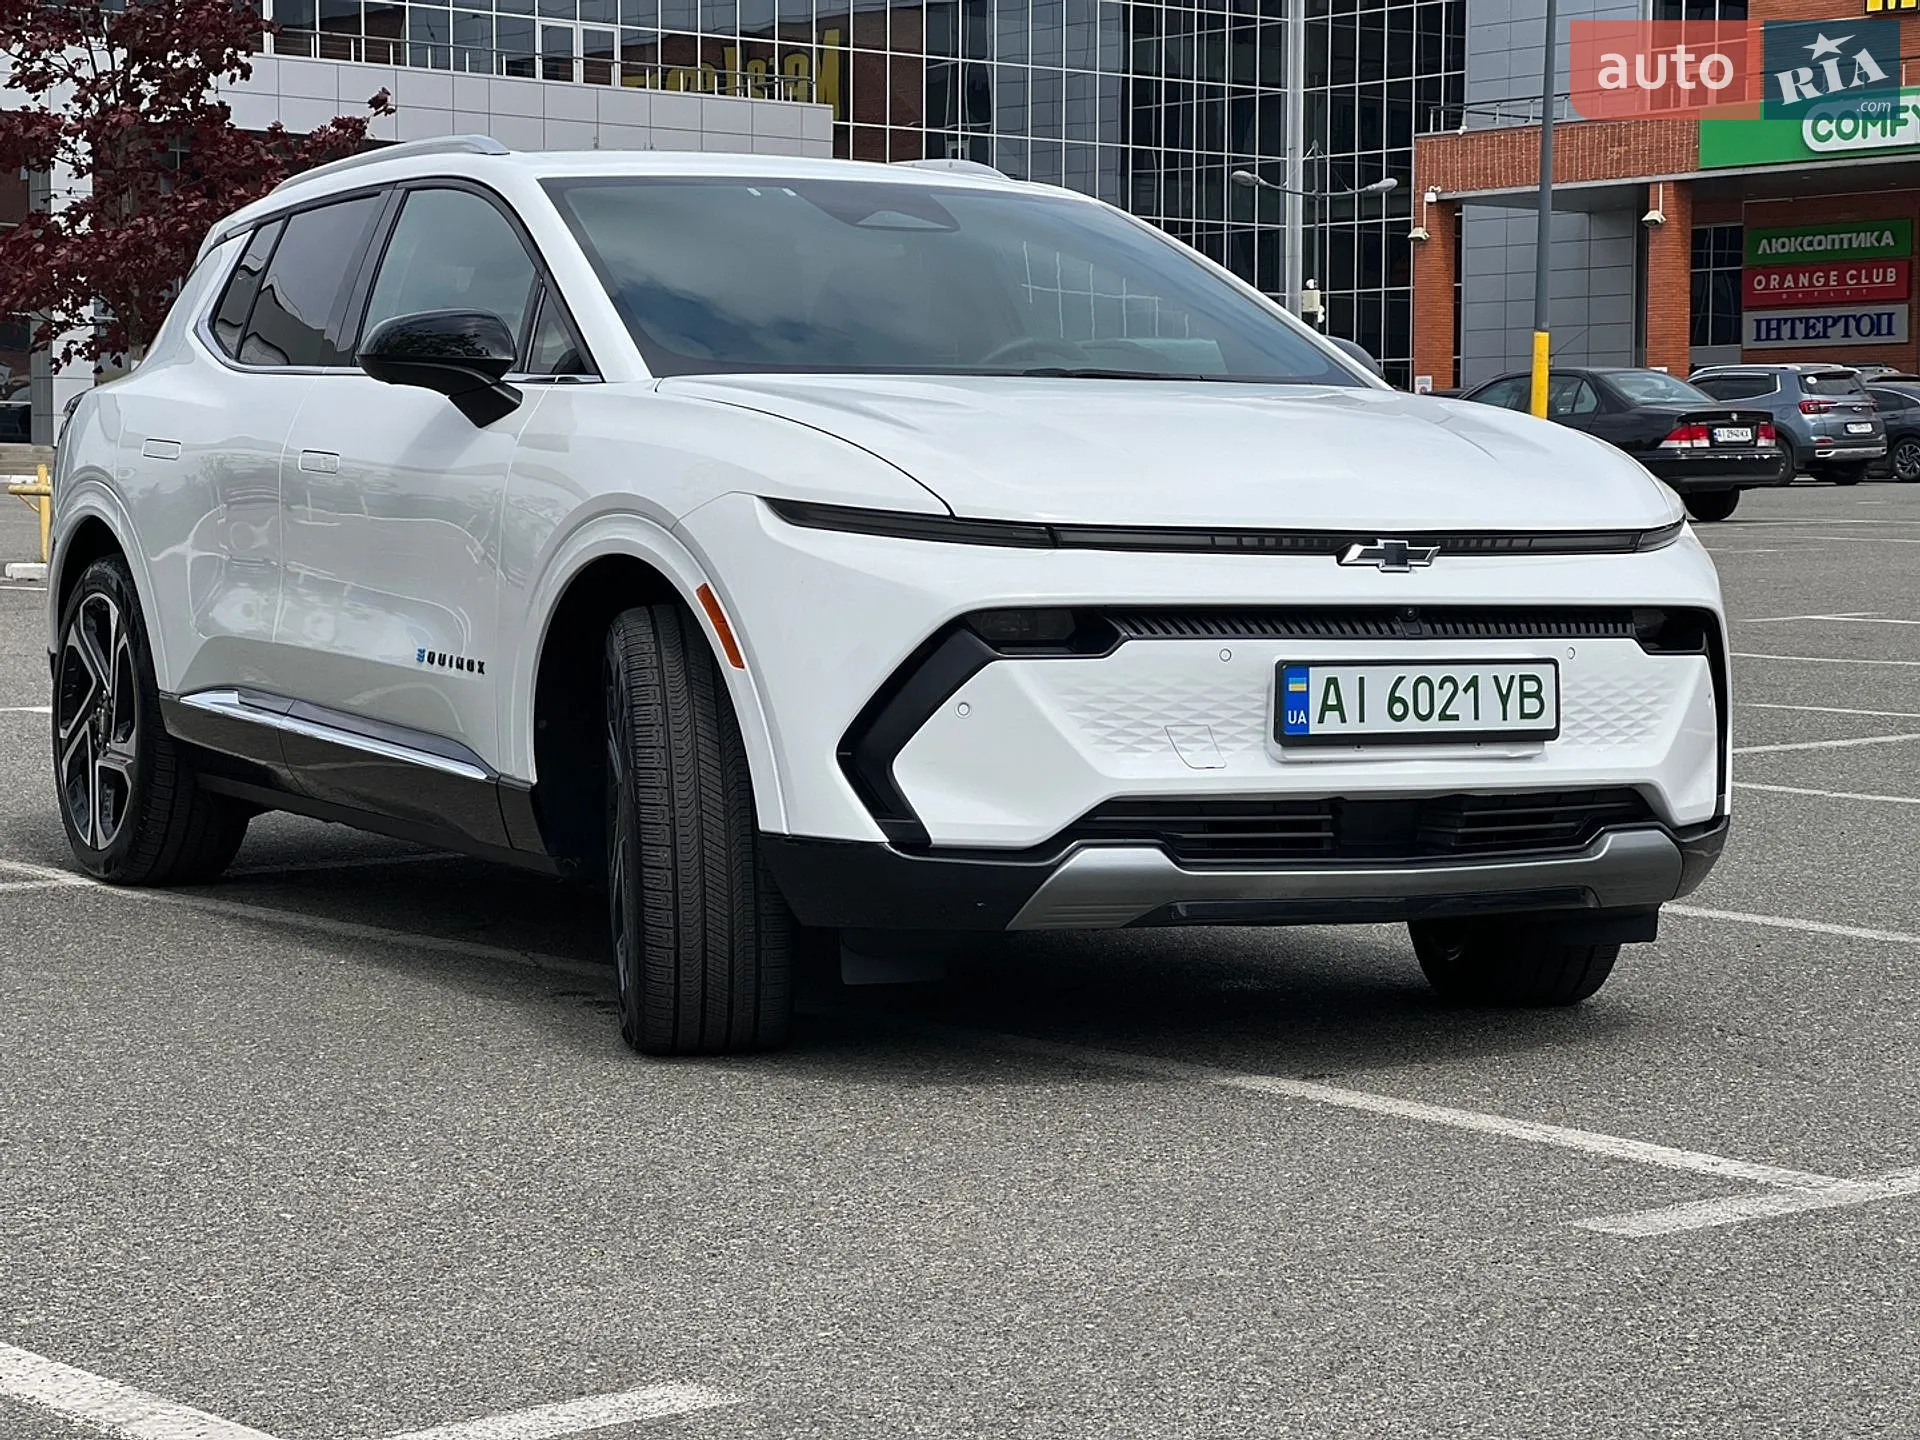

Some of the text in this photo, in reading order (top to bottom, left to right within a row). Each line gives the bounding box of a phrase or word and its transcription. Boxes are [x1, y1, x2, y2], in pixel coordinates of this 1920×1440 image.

[1757, 230, 1895, 255] ЛЮКСОПТИКА
[1753, 267, 1897, 290] ORANGE CLUB
[1752, 312, 1896, 342] ІНТЕРТОП
[416, 648, 485, 675] EQUINOX
[1317, 673, 1546, 724] AI 6021 YB
[1288, 710, 1307, 724] UA
